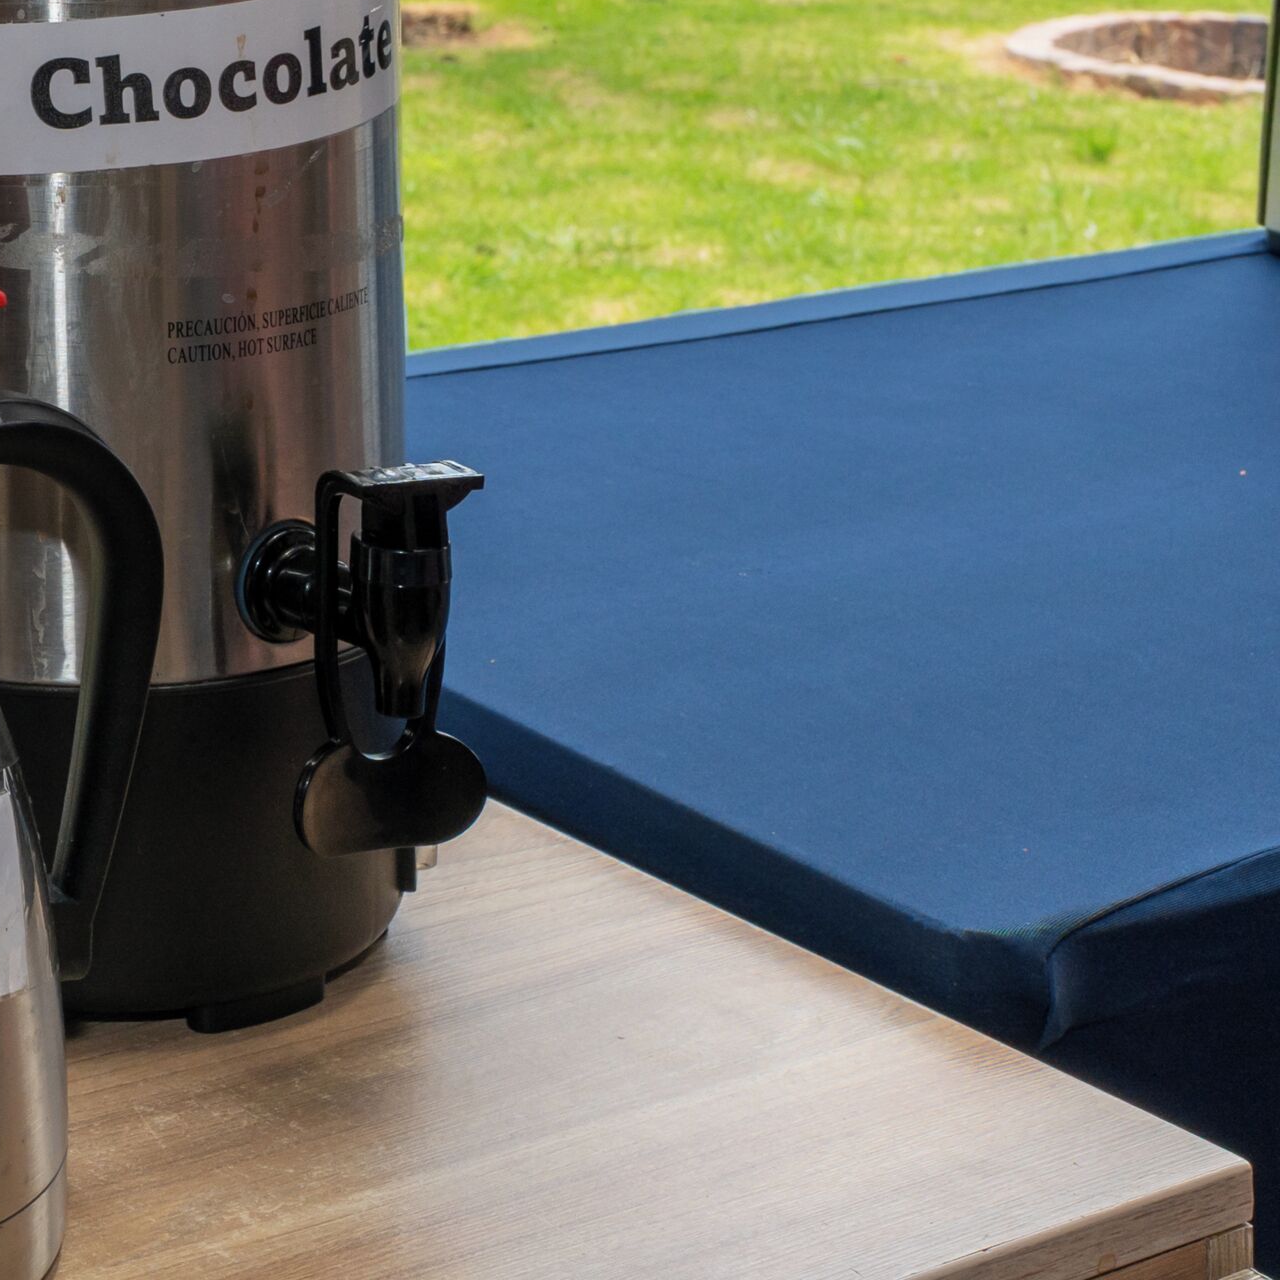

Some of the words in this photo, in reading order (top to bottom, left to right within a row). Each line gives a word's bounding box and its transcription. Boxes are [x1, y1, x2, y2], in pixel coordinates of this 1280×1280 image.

[30, 15, 392, 130] Chocolate
[262, 301, 326, 329] SUPERFICIE
[327, 286, 369, 317] CALIENTE
[167, 341, 236, 364] CAUTION,
[238, 337, 264, 357] HOT
[266, 328, 317, 354] SURFACE
